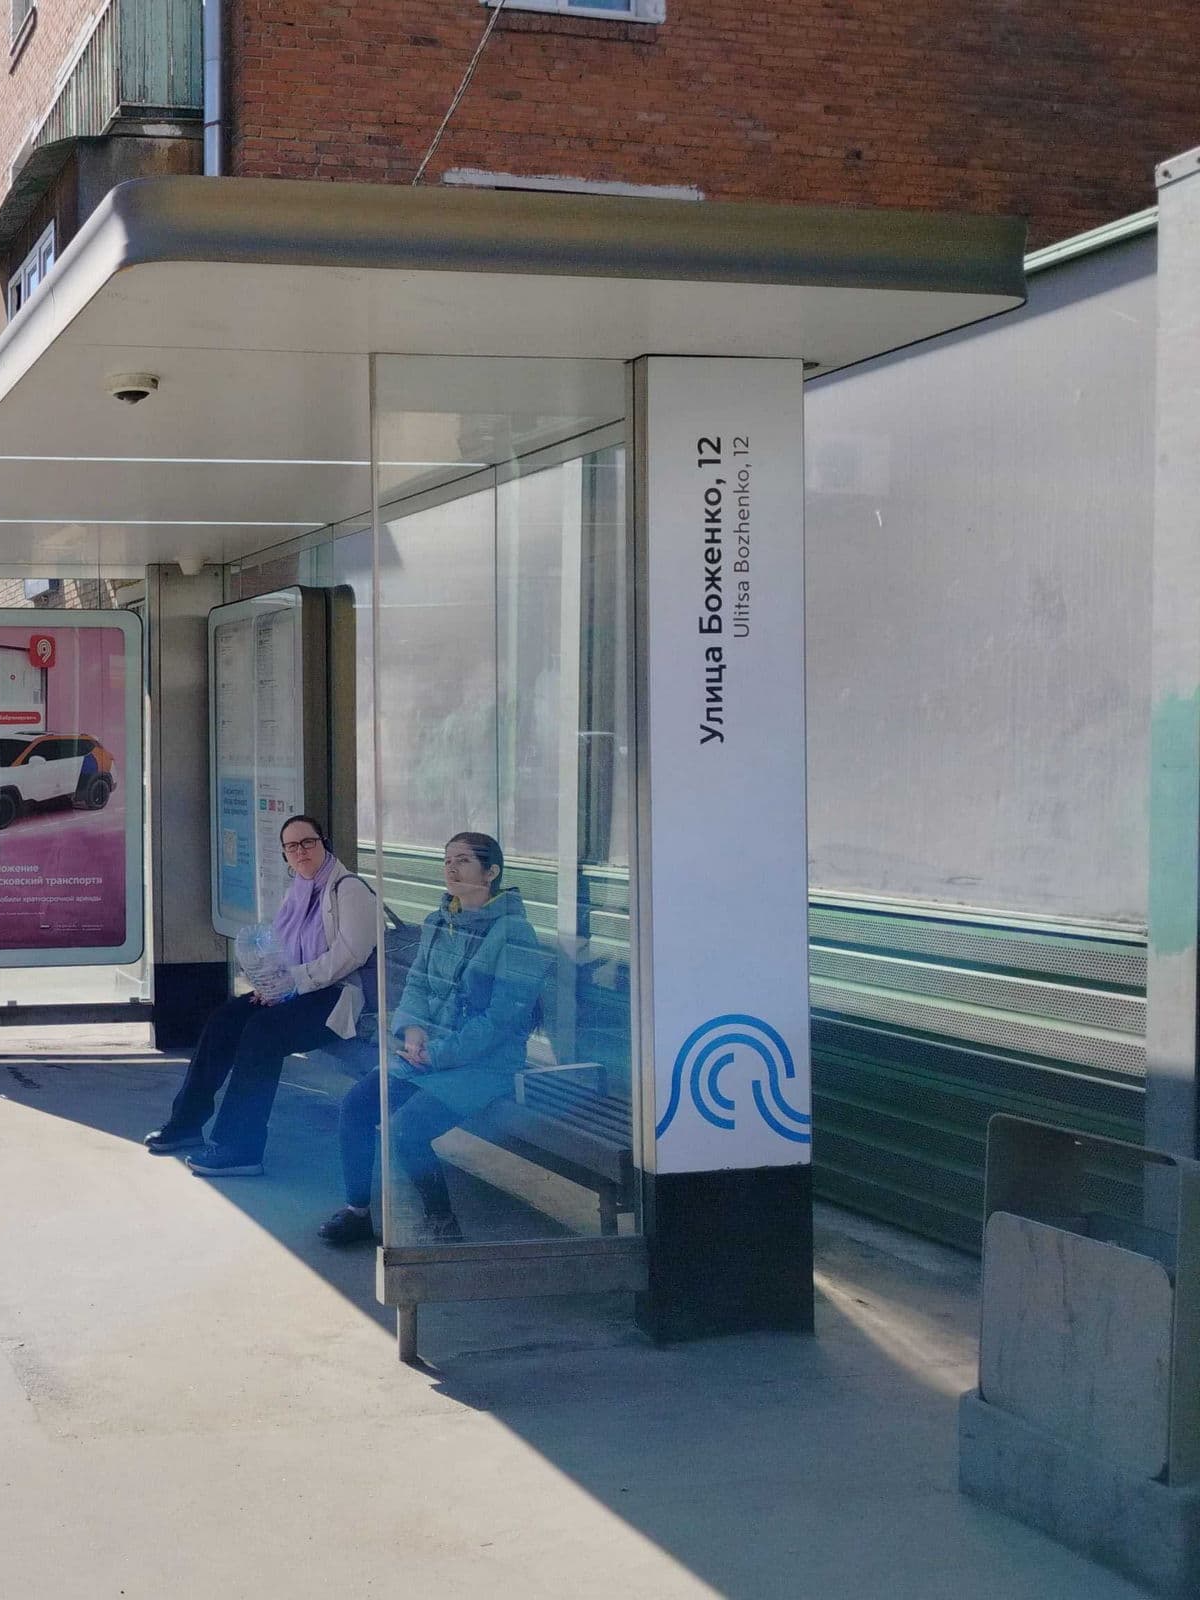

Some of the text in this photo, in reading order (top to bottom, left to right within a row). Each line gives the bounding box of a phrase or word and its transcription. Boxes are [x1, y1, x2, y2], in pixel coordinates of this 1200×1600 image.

[697, 436, 727, 745] Улица Боженко, 12
[732, 436, 753, 638] Ulitsa Bozhenko, 12
[46, 876, 103, 887] транспорт»
